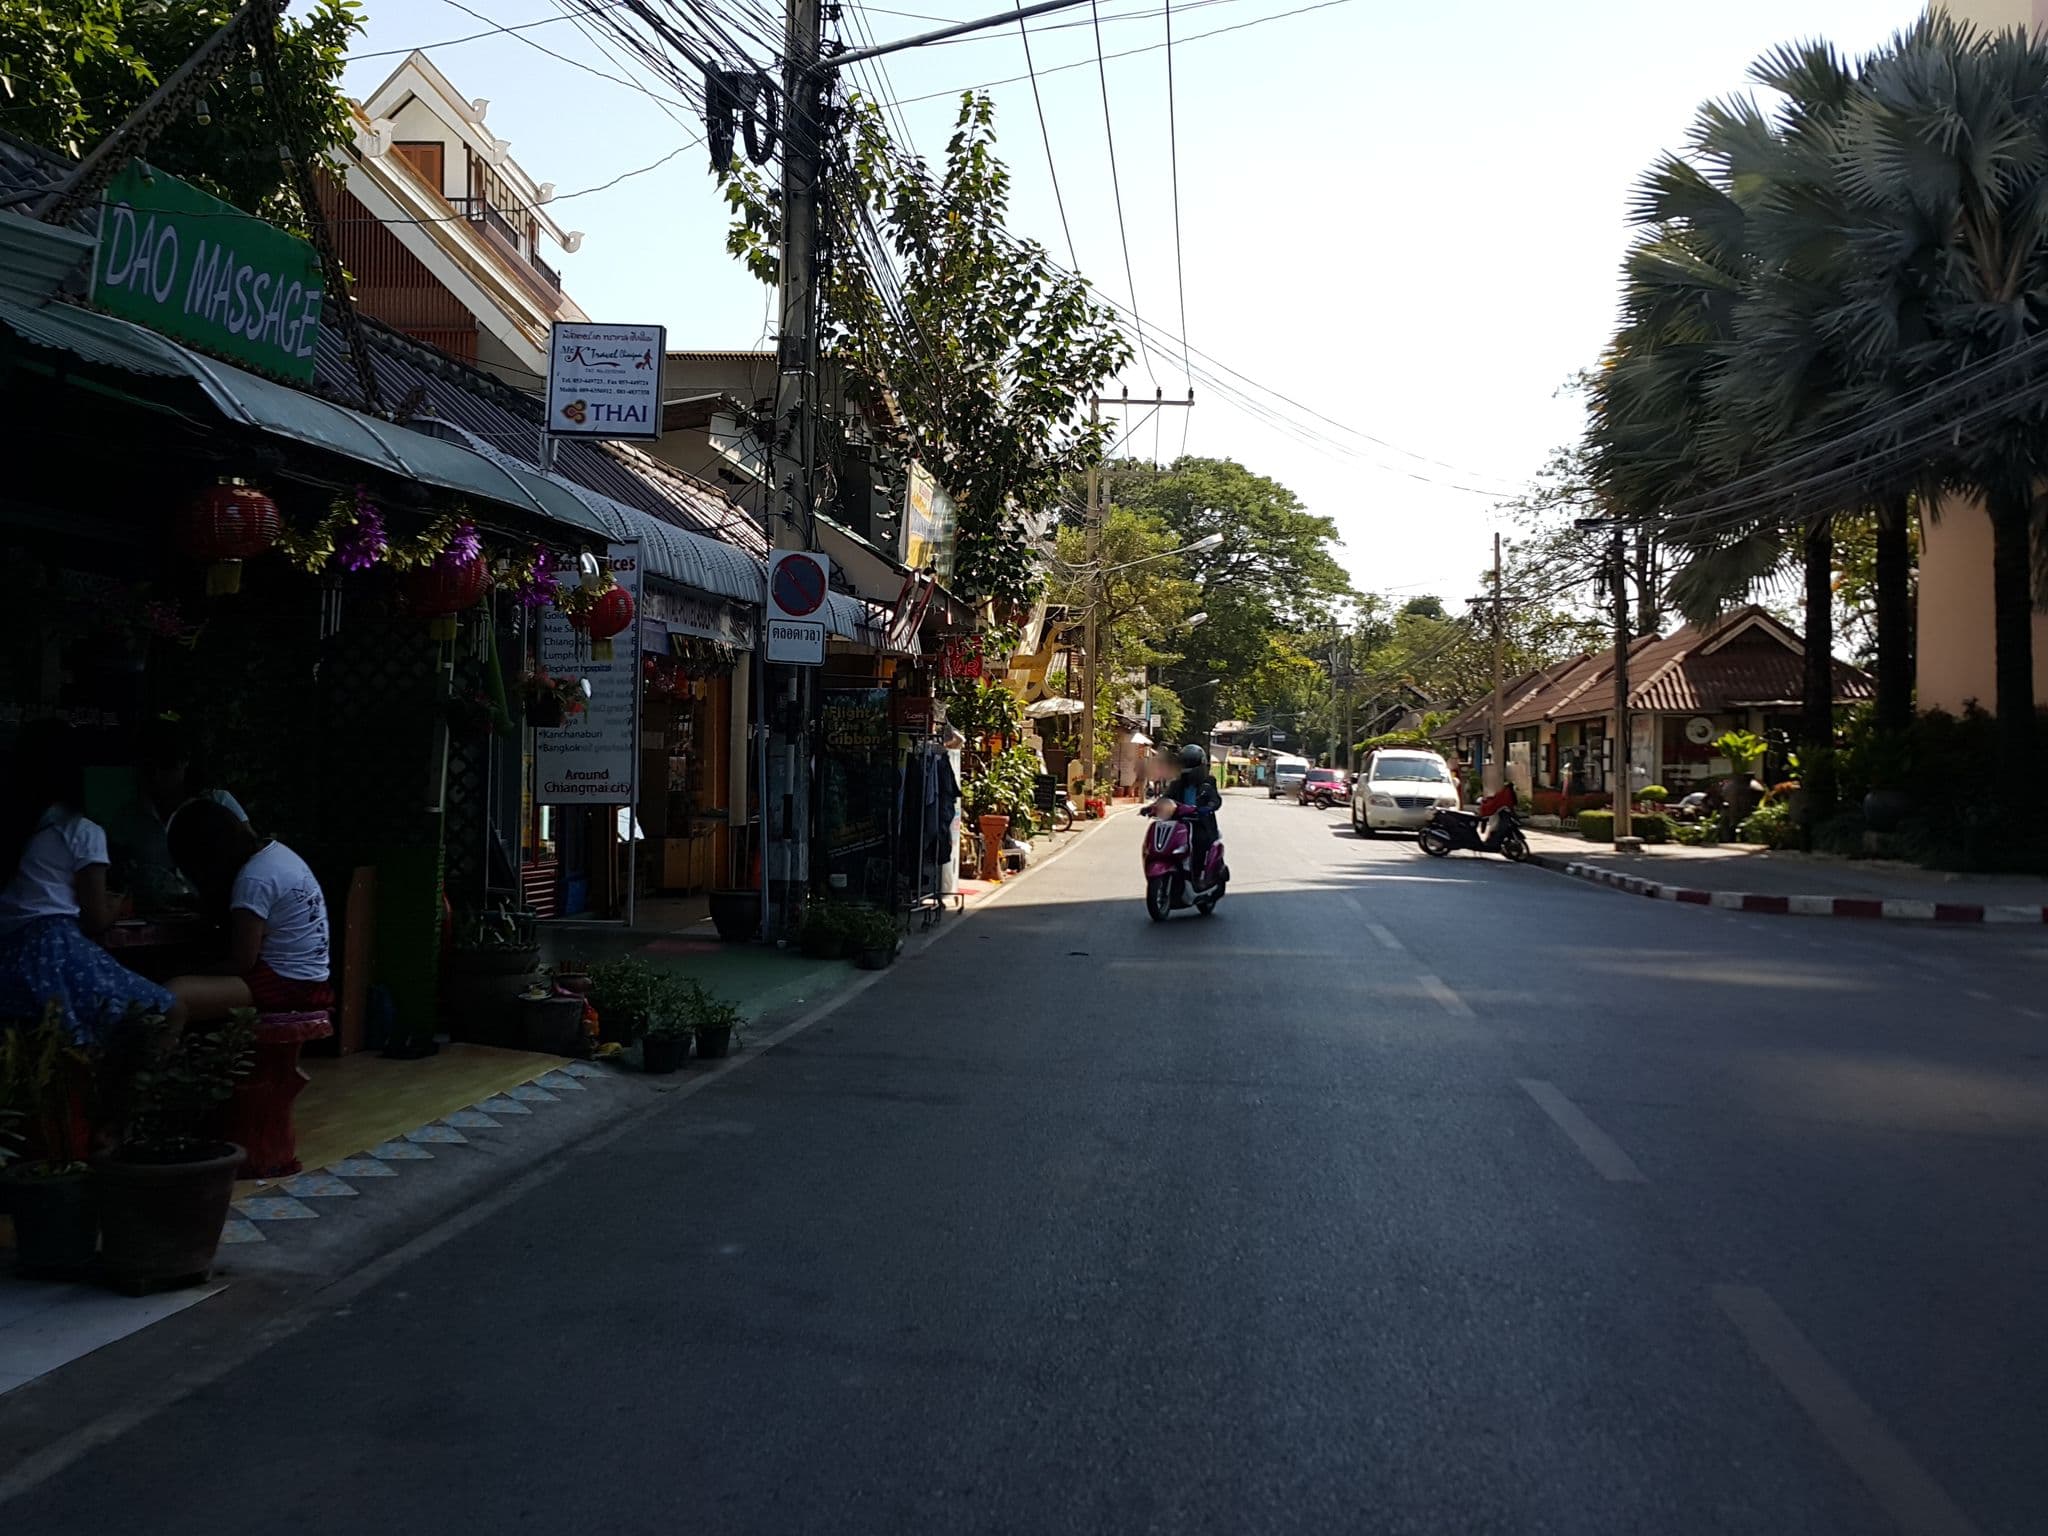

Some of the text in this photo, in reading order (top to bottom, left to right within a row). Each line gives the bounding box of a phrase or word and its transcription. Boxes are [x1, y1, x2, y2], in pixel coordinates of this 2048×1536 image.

[106, 202, 322, 358] DAO MASSAGE
[591, 348, 619, 360] Travel
[590, 403, 648, 423] THAI
[772, 626, 821, 642] ตลอดเวลา
[826, 731, 881, 745] Gibbon
[565, 769, 609, 780] Around
